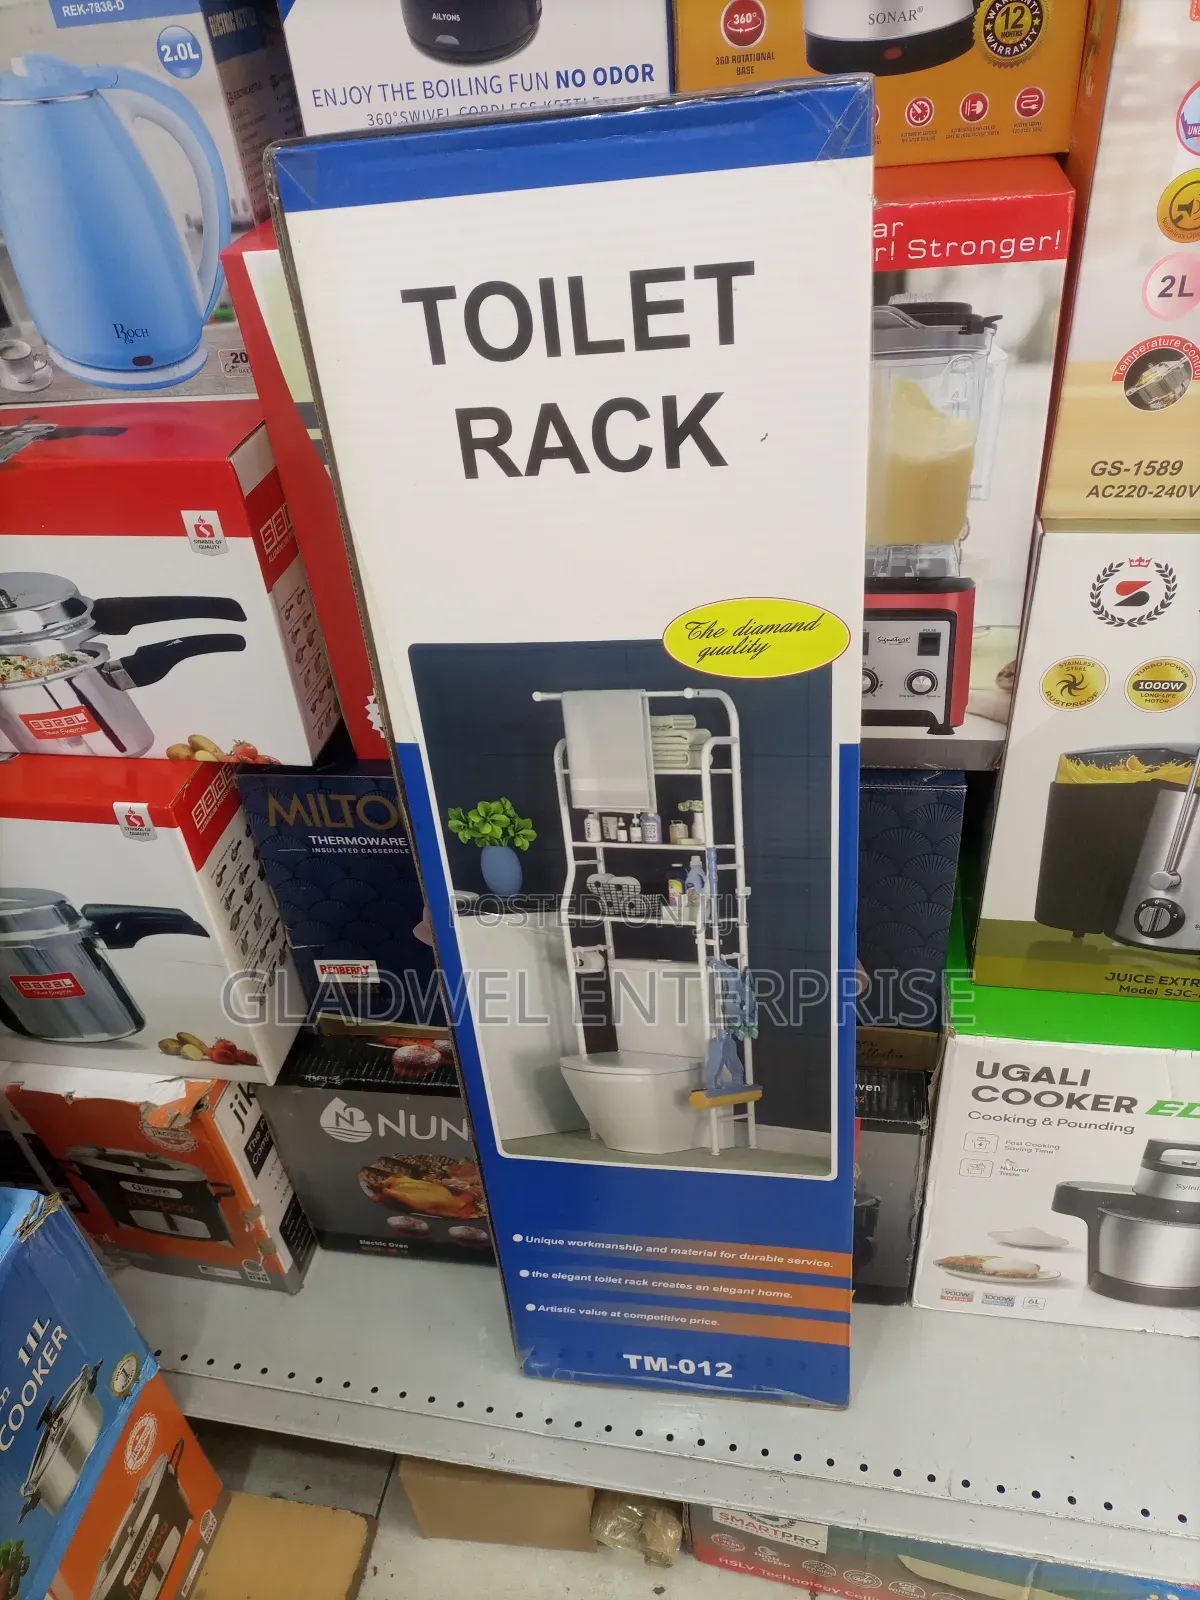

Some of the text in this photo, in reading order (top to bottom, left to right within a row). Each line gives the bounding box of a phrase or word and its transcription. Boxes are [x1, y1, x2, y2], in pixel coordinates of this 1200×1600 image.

[62, 1, 125, 17] REK-7838-D
[432, 12, 460, 21] AILYONS
[1001, 5, 1026, 31] 12
[986, 28, 1038, 56] WARRANTY
[1000, 30, 1023, 38] MONTHS
[161, 42, 200, 62] 2.0L
[715, 52, 776, 65] 360 ROTATIONAL
[736, 66, 755, 75] BASE
[312, 63, 655, 107] ENJOY THE BOILING FUN NO ODOR
[907, 230, 1061, 260] Stronger!
[1158, 274, 1195, 298] 2L
[400, 261, 755, 366] TOILET
[1114, 337, 1181, 377] Temperature
[455, 392, 729, 479] RACK
[1090, 459, 1184, 477] GS-1589
[685, 612, 826, 640] The diamand
[696, 636, 771, 664] quality
[1058, 660, 1097, 669] STAINLESS
[1135, 662, 1190, 679] TURBO POWER
[1138, 681, 1184, 691] 1000W
[1044, 690, 1100, 708] RUSTPROOF
[308, 836, 408, 846] THERMOWARE
[319, 965, 370, 975] REDBERRY
[1104, 972, 1200, 988] JUICE EXTR
[1119, 985, 1159, 995] Model
[975, 1060, 1092, 1087] UGALI
[971, 1085, 1138, 1114] COOKER
[968, 1110, 1136, 1135] Cooking & Pounding
[1004, 1145, 1033, 1154] Saving
[1025, 1141, 1061, 1150] Cooking
[359, 1239, 387, 1247] Electric
[525, 1236, 834, 1268] Unique workmanship and material for durable service.
[551, 1272, 592, 1282] elegant
[594, 1275, 622, 1284] toilet
[624, 1278, 649, 1286] rack
[651, 1280, 693, 1290] creates
[712, 1286, 755, 1296] elegant
[757, 1289, 793, 1299] home.
[537, 1304, 576, 1314] Artistic
[579, 1308, 608, 1317] value
[623, 1312, 687, 1324] competitive
[689, 1317, 720, 1327] price.
[623, 1353, 733, 1378] TM-012
[0, 1325, 68, 1452] COOKER
[719, 1511, 820, 1547] SMARTPRO
[753, 1551, 780, 1562] HIGH
[762, 1557, 791, 1568] SPEED
[719, 1557, 755, 1571] HSLV
[758, 1568, 841, 1595] Technology
